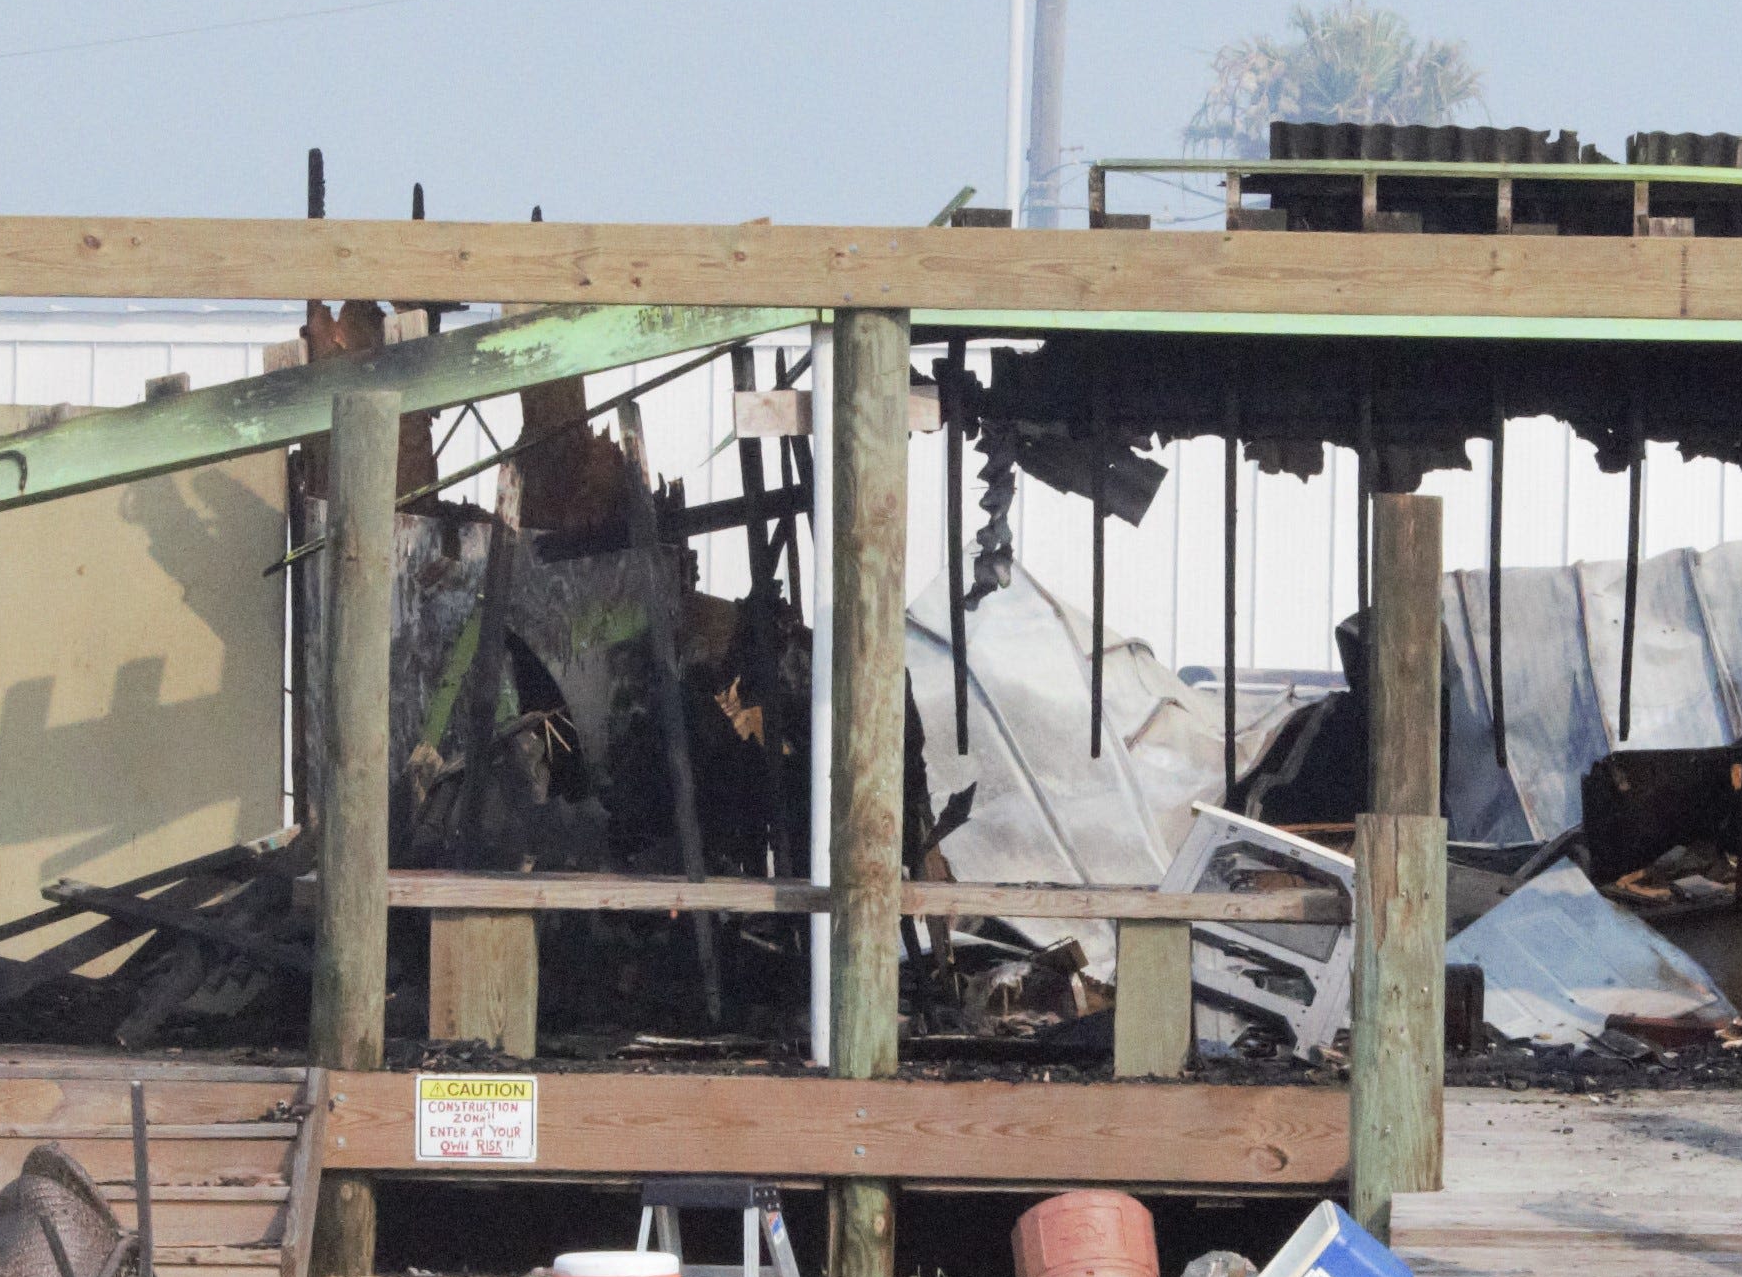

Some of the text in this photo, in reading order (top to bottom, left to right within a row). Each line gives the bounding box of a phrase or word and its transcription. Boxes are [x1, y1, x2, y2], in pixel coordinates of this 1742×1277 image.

[447, 1082, 525, 1096] CAUTION
[428, 1101, 518, 1113] CONSTRUCTION
[429, 1124, 521, 1138] ENTER AT YOUR
[477, 1139, 503, 1153] RISK
